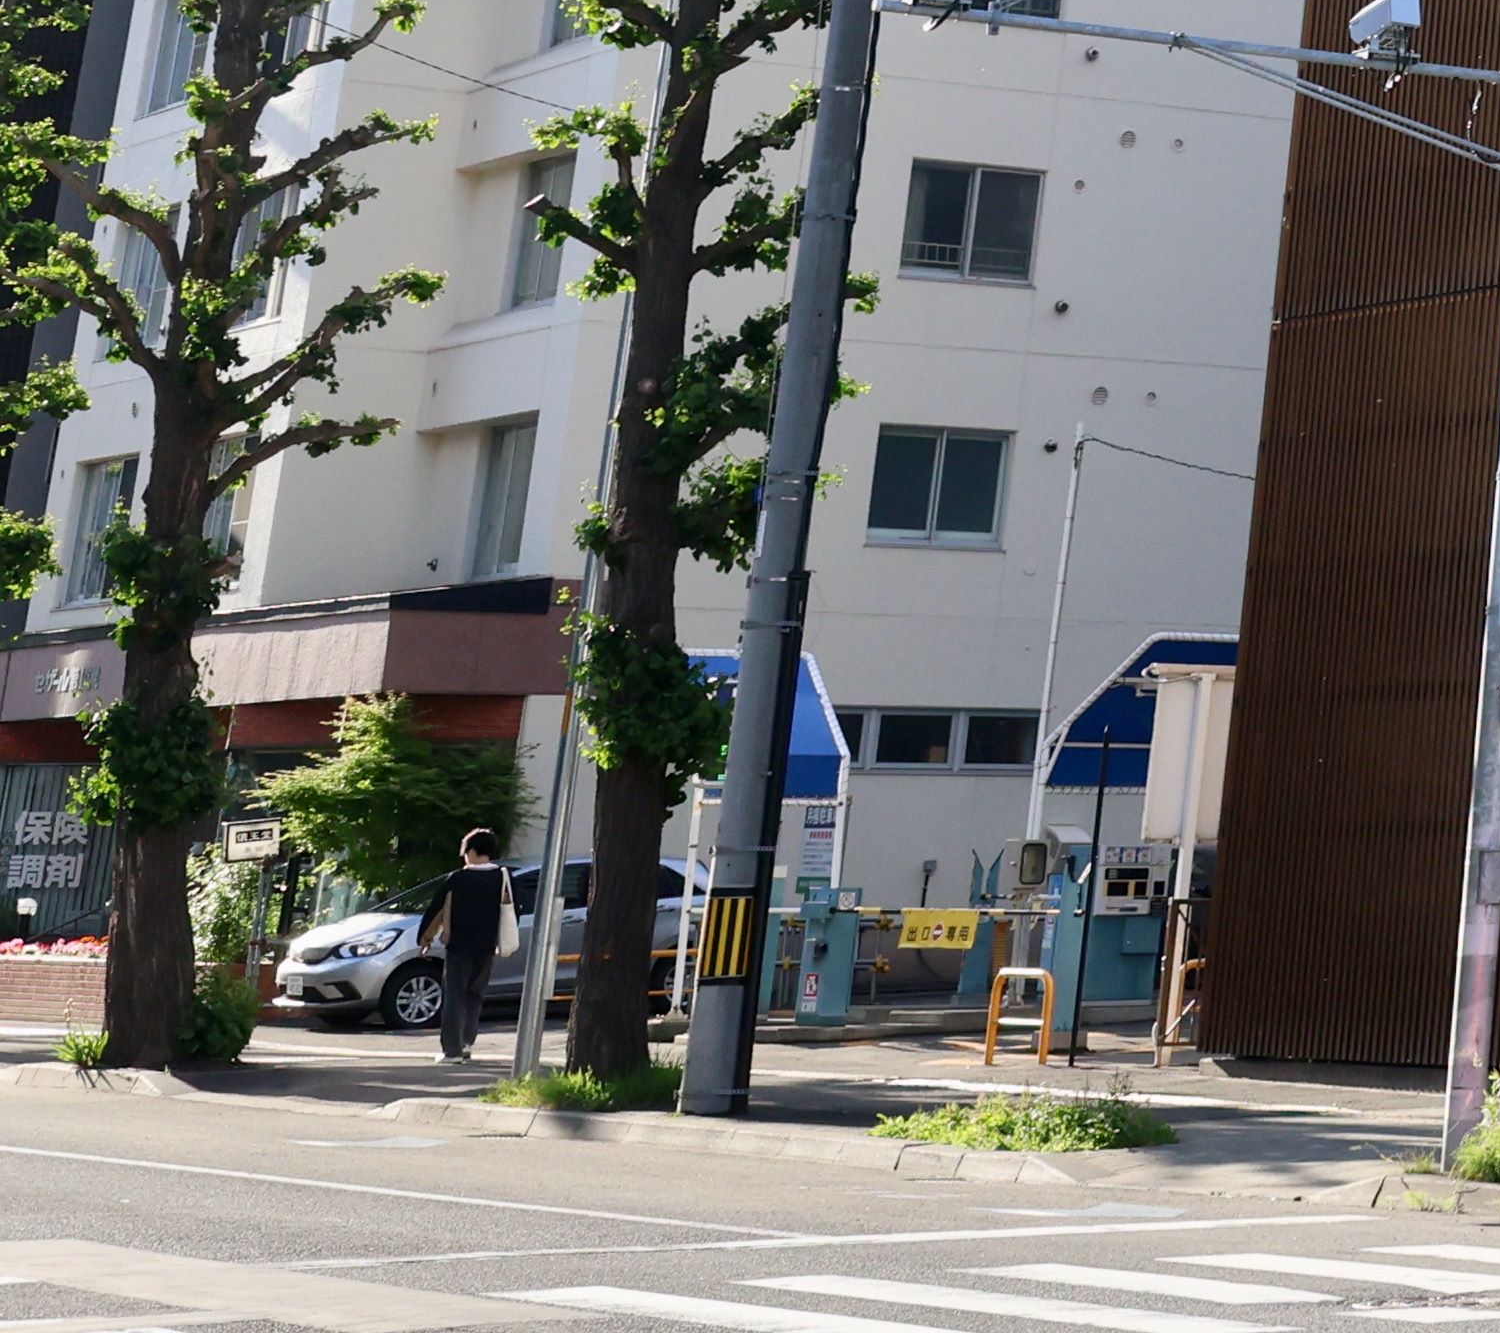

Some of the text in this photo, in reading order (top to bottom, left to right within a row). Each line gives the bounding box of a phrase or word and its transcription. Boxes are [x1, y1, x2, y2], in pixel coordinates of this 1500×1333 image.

[14, 810, 89, 846] 保険
[7, 852, 84, 889] 調剤
[906, 926, 931, 942] 出口
